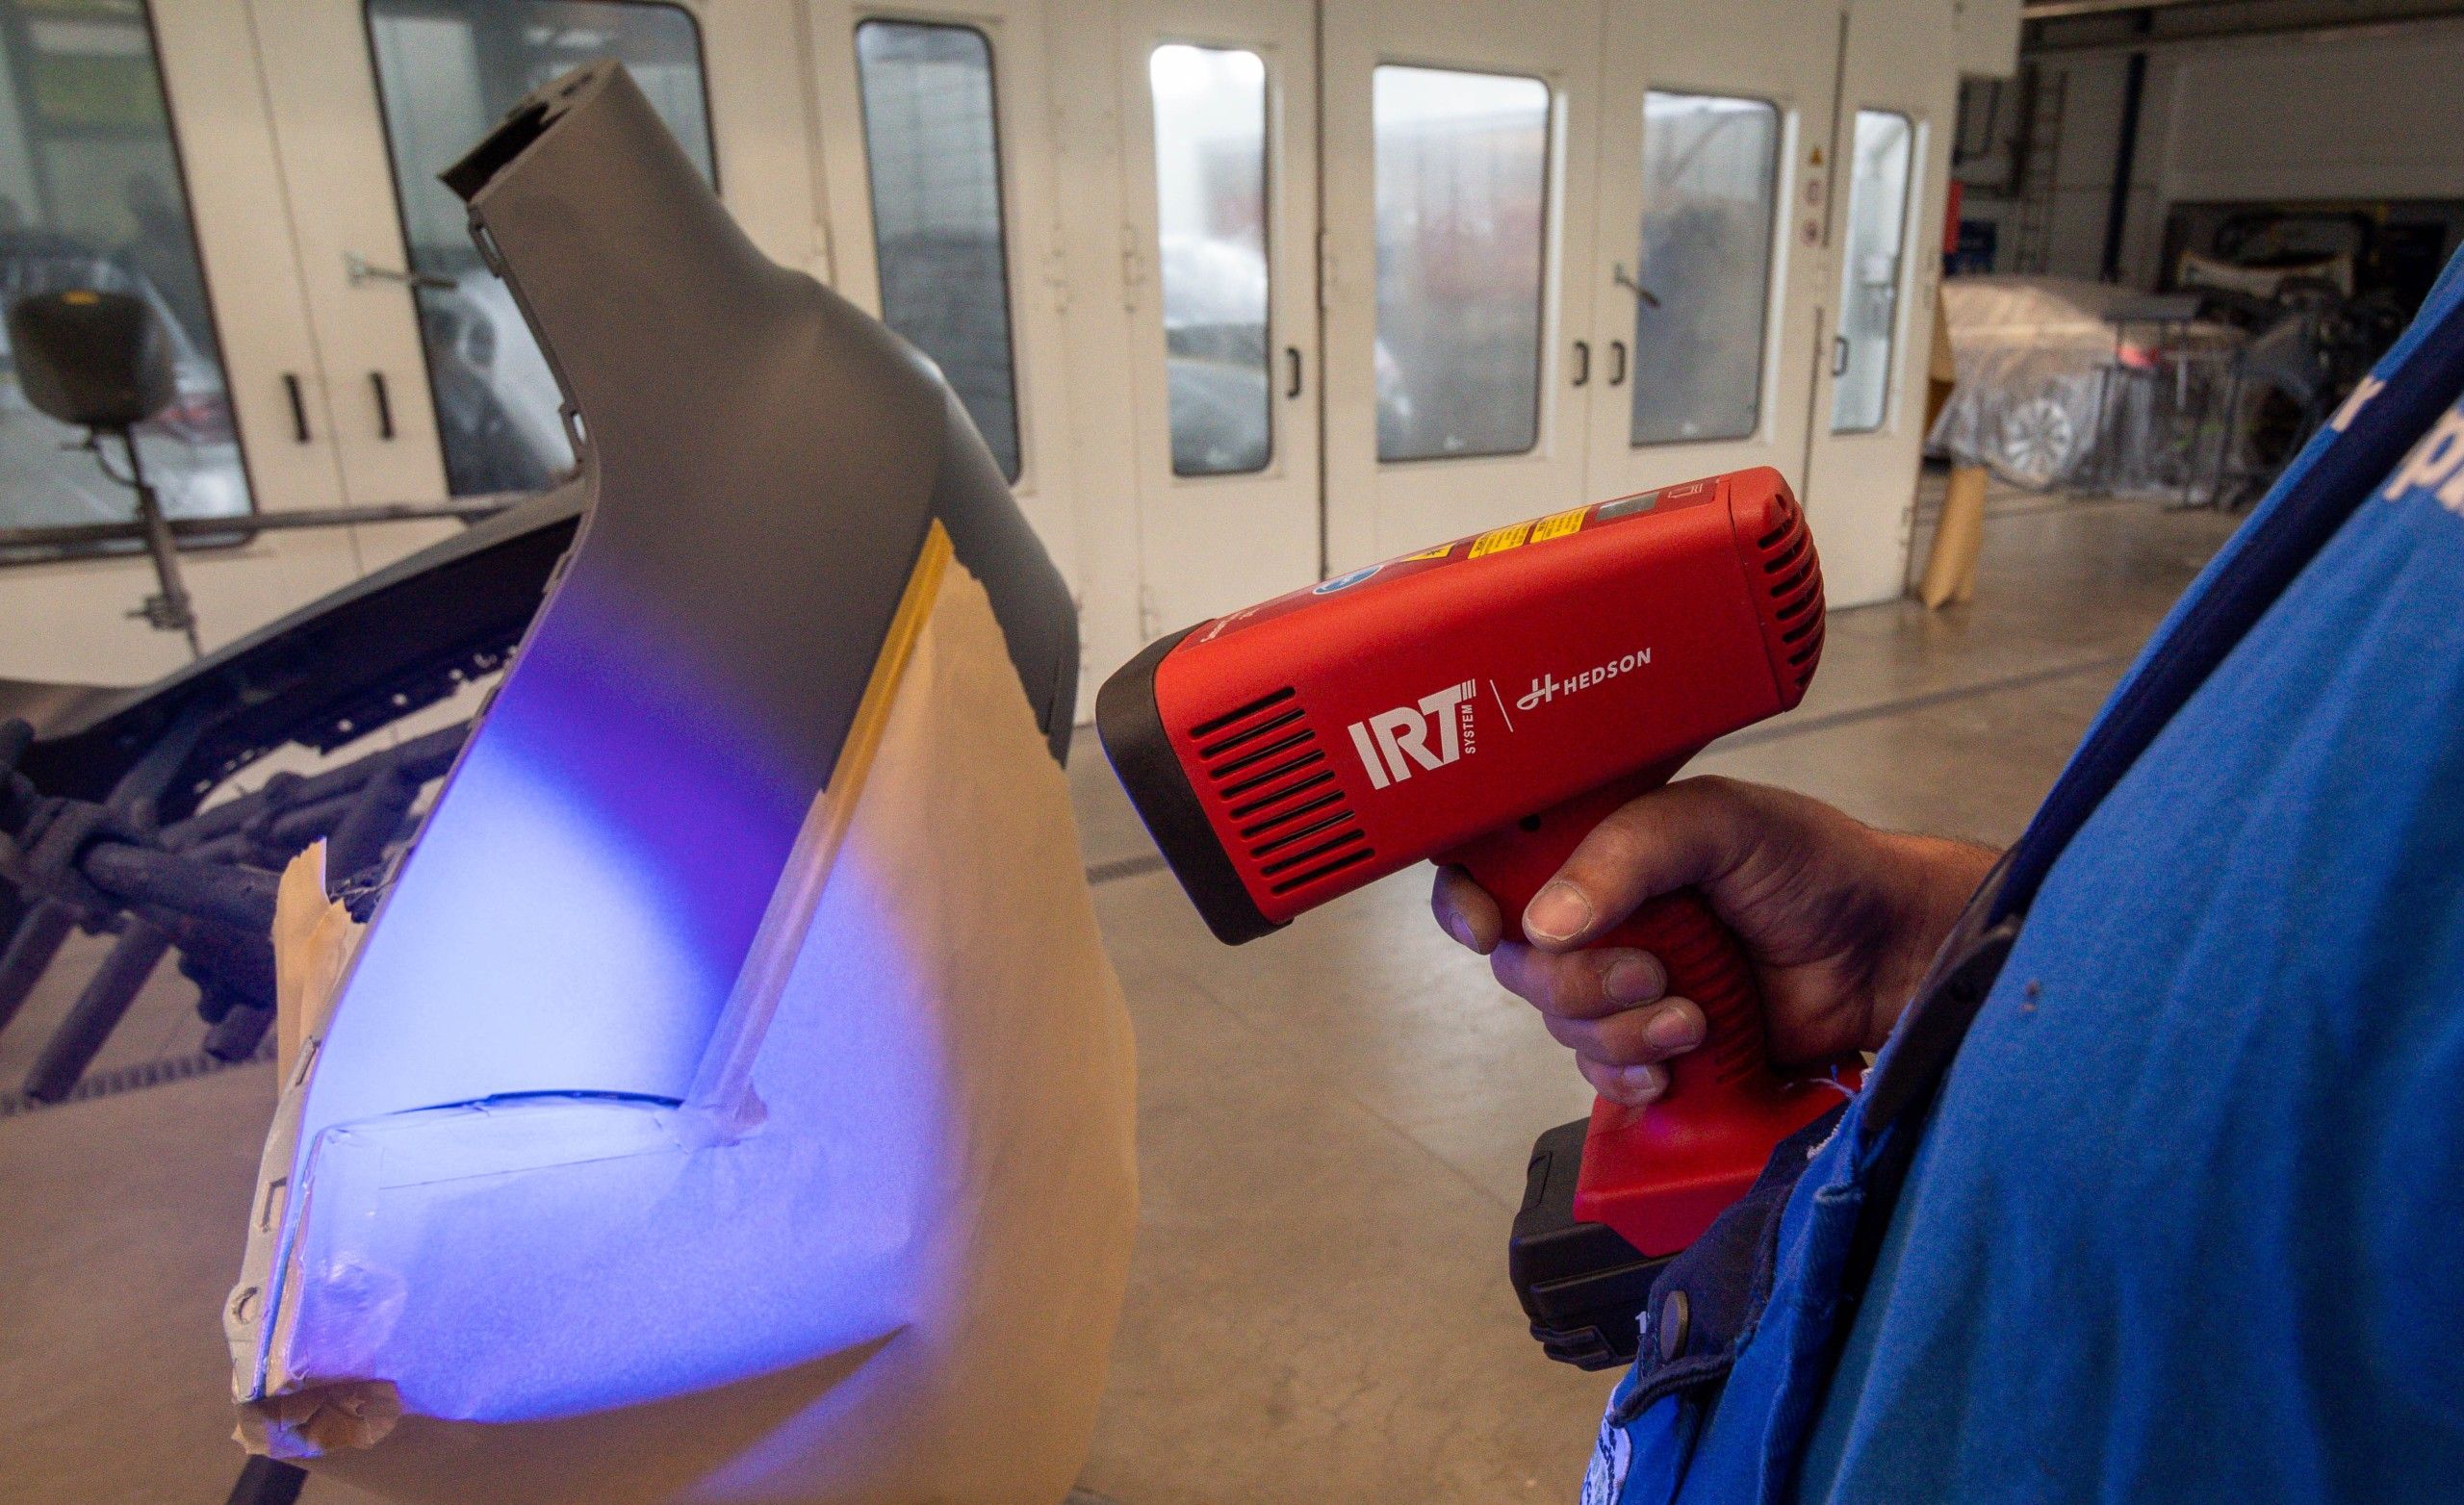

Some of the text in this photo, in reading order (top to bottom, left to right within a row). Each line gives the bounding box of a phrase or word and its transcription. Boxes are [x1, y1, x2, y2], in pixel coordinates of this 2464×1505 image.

[1563, 647, 1652, 696] HEDSON
[1348, 683, 1461, 790] IRT
[1461, 703, 1476, 754] SYSTEM
